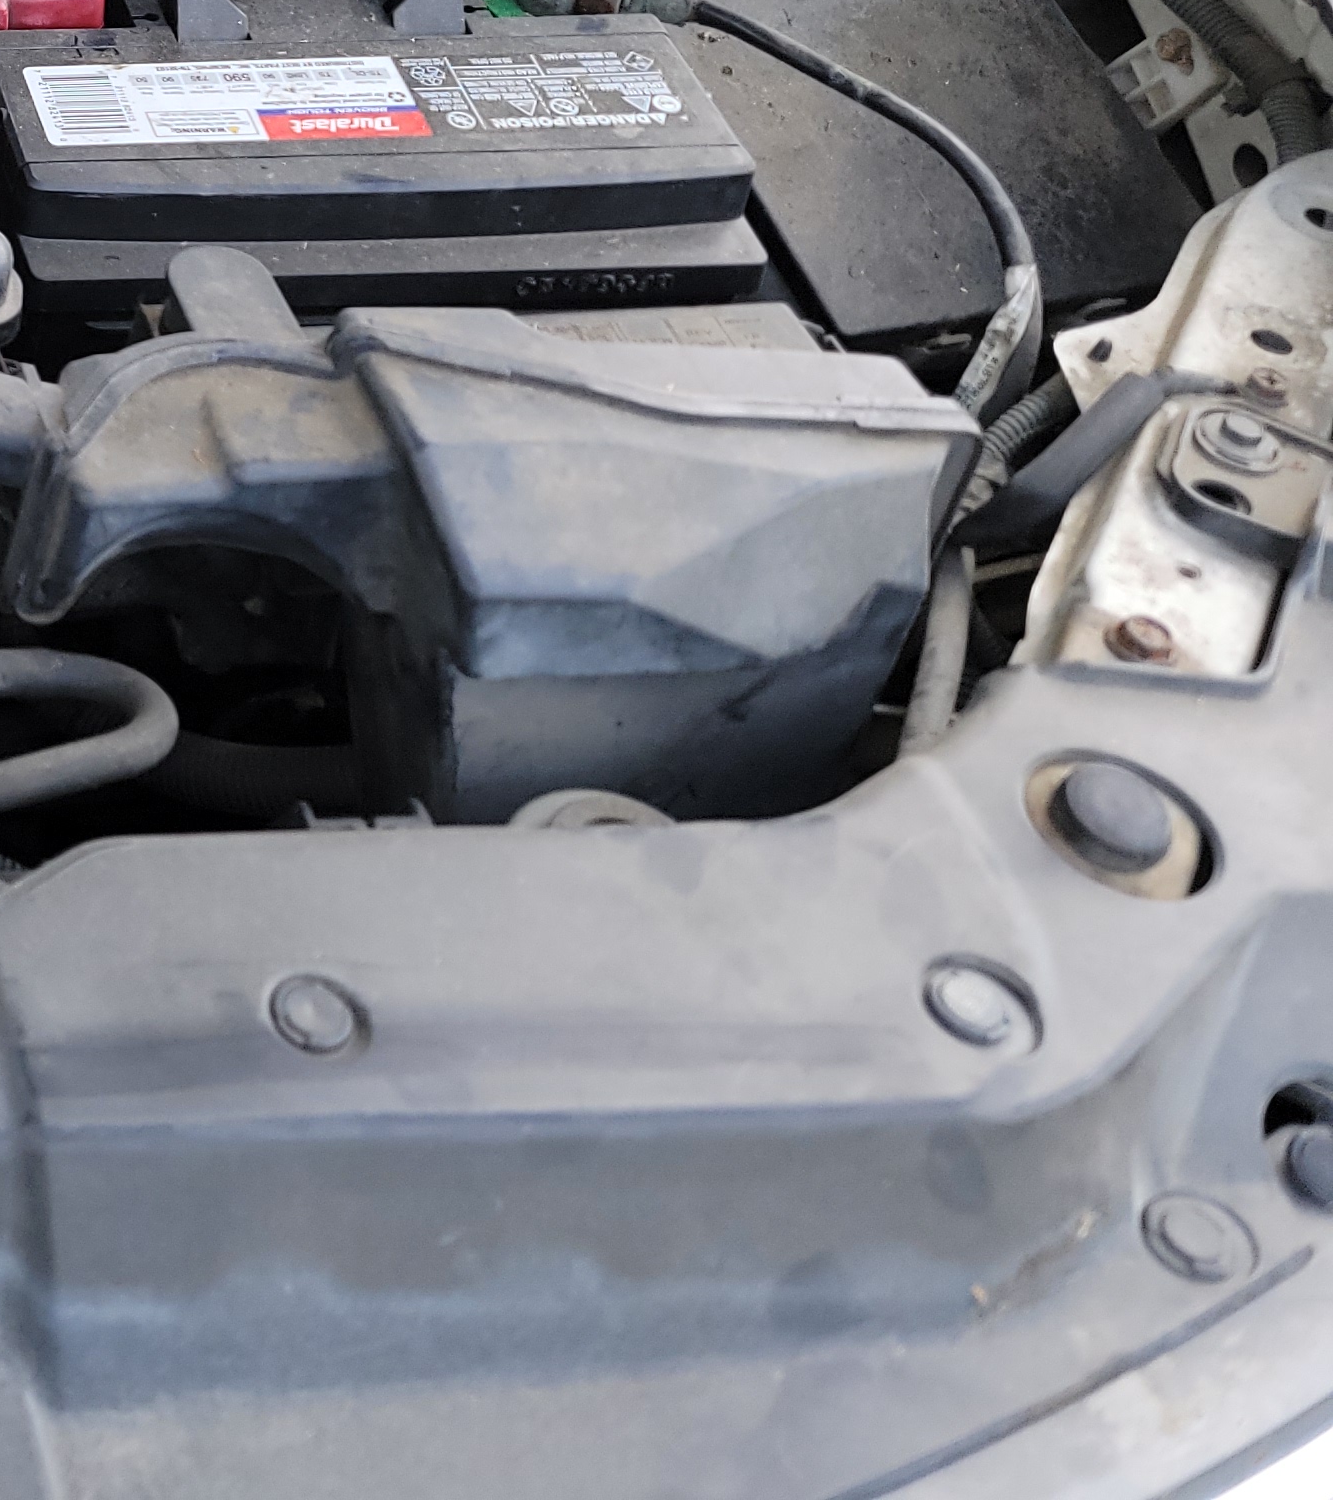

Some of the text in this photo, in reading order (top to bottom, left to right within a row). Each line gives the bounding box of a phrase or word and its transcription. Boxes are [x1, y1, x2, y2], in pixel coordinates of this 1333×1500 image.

[223, 73, 251, 82] 590
[289, 116, 399, 133] Duralast
[489, 113, 652, 130] DANGER/POISON
